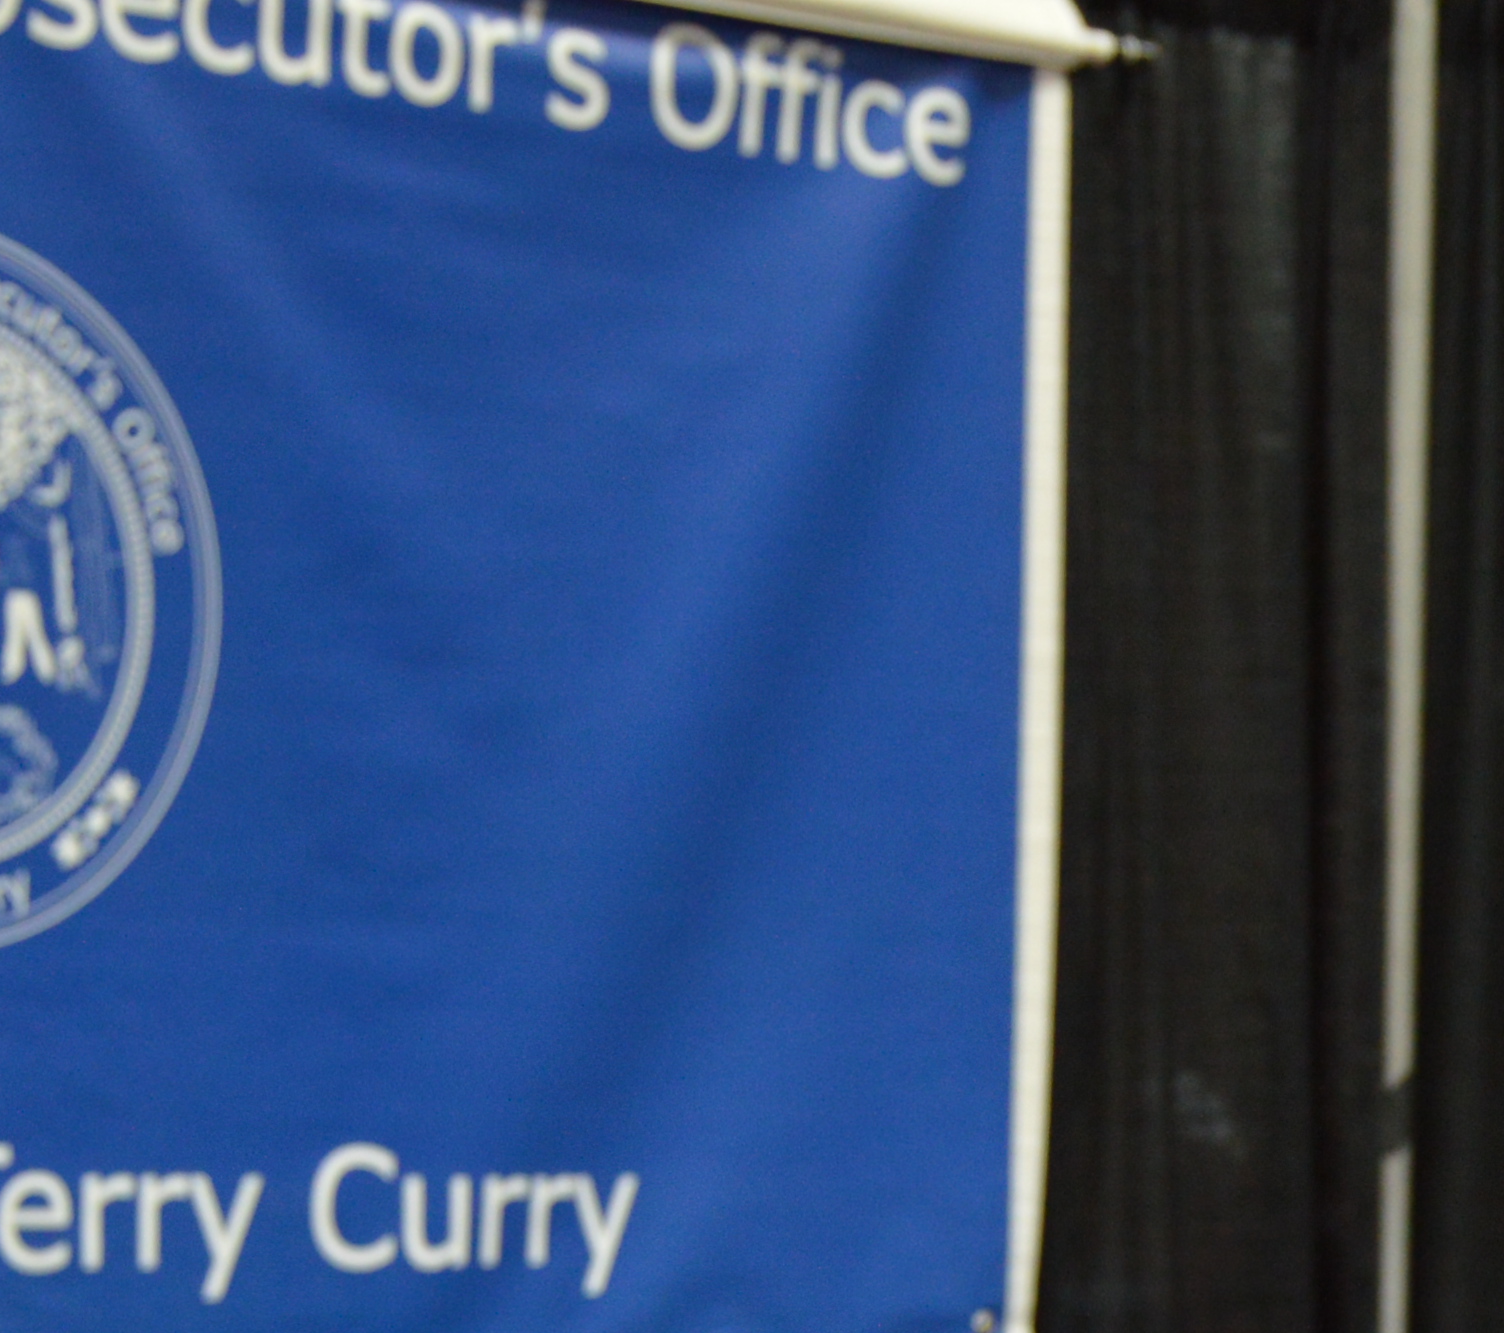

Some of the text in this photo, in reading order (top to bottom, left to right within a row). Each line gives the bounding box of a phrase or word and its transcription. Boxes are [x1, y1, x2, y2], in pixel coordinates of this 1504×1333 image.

[646, 25, 970, 185] Office
[112, 406, 184, 555] Office
[310, 1140, 640, 1300] Curry
